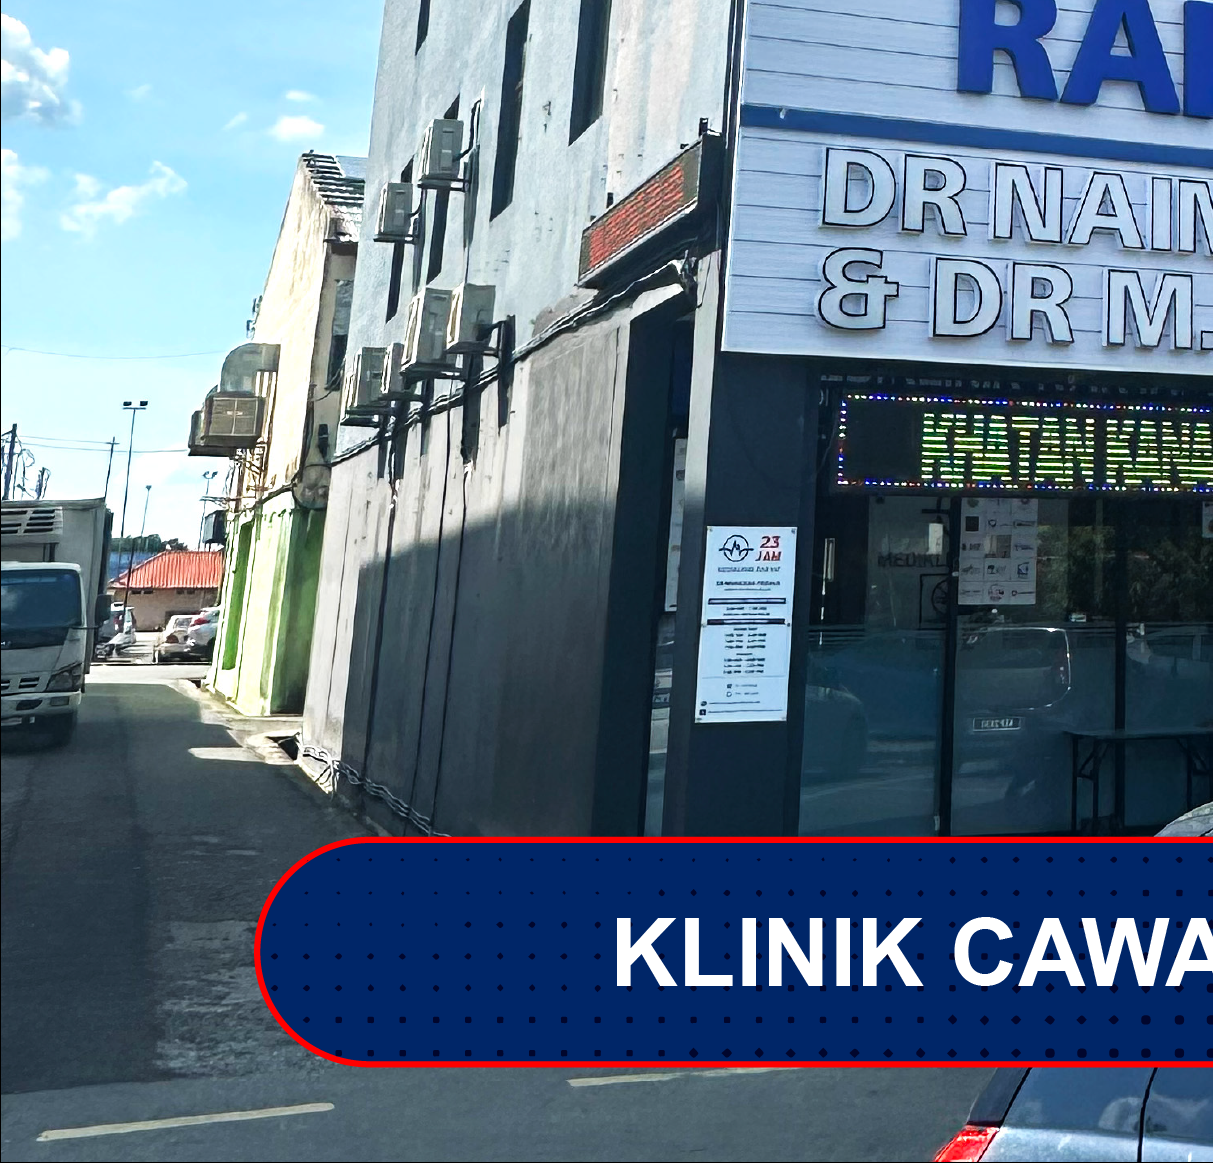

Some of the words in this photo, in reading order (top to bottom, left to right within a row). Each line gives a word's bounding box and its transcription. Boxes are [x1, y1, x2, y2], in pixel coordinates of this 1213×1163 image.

[819, 145, 970, 238] DR
[815, 246, 899, 332] &
[929, 256, 1076, 346] DR
[921, 413, 1095, 483] KHATAN
[755, 551, 782, 561] JAM
[760, 536, 781, 549] 23
